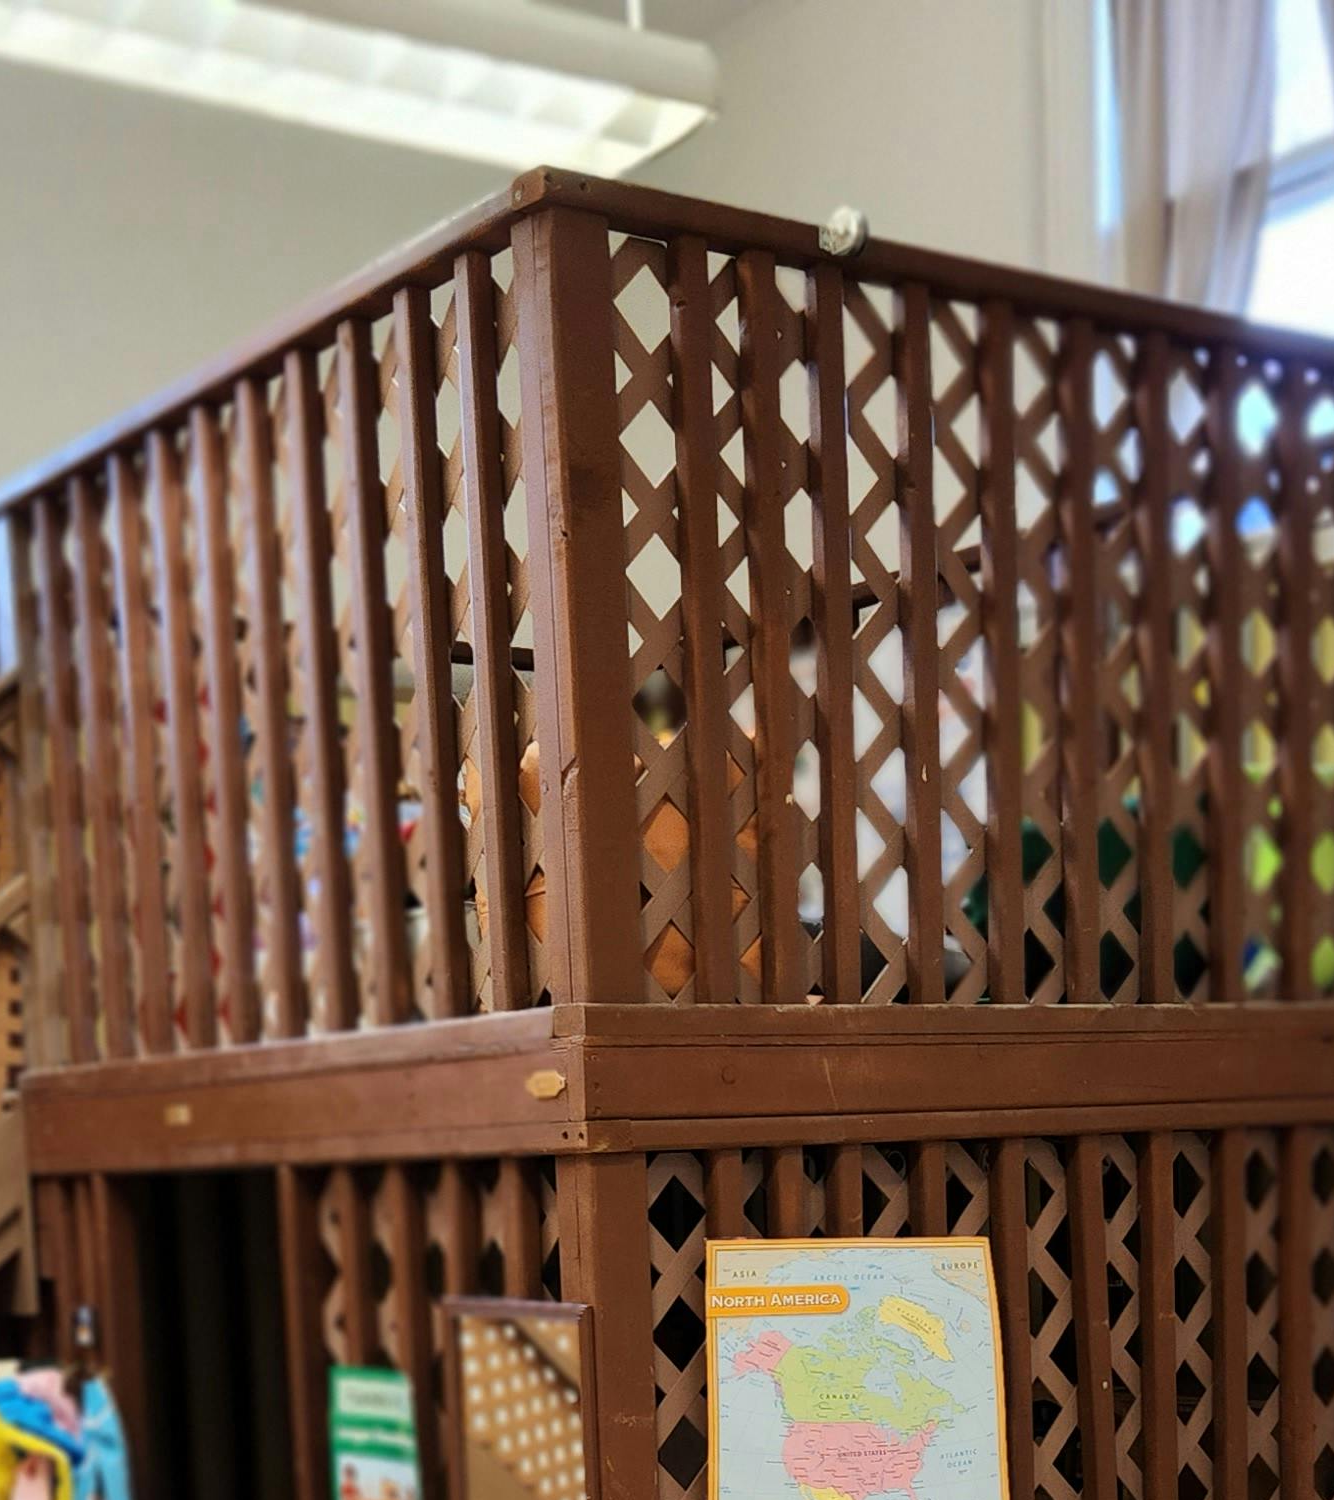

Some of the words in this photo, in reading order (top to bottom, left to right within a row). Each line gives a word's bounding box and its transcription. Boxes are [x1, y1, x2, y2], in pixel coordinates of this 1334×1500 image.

[941, 1261, 979, 1270] EUROPE
[732, 1270, 757, 1279] ASIA
[711, 1295, 765, 1308] NORTH
[771, 1292, 841, 1307] AMERICA
[940, 1448, 979, 1459] ATLANTIC
[946, 1460, 973, 1469] OCEAN
